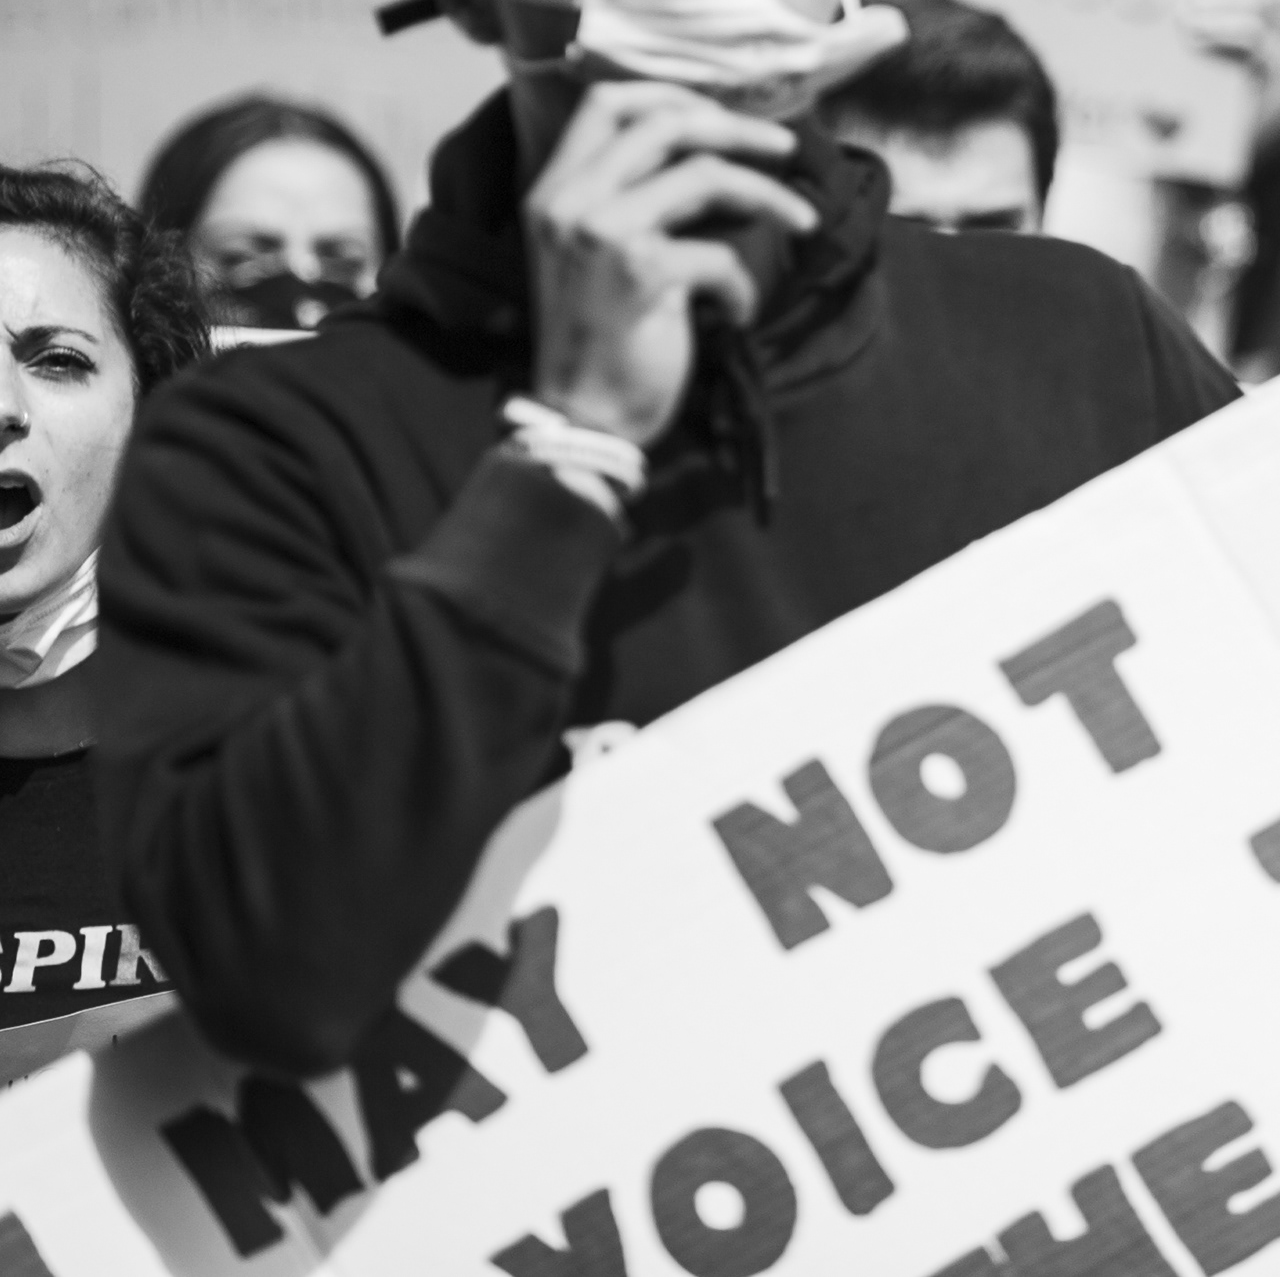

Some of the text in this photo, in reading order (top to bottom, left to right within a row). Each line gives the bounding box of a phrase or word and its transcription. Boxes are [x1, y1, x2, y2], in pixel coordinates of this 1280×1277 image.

[155, 905, 589, 1260] MAY
[710, 597, 1163, 951] NOT
[489, 912, 1164, 1277] VOICE
